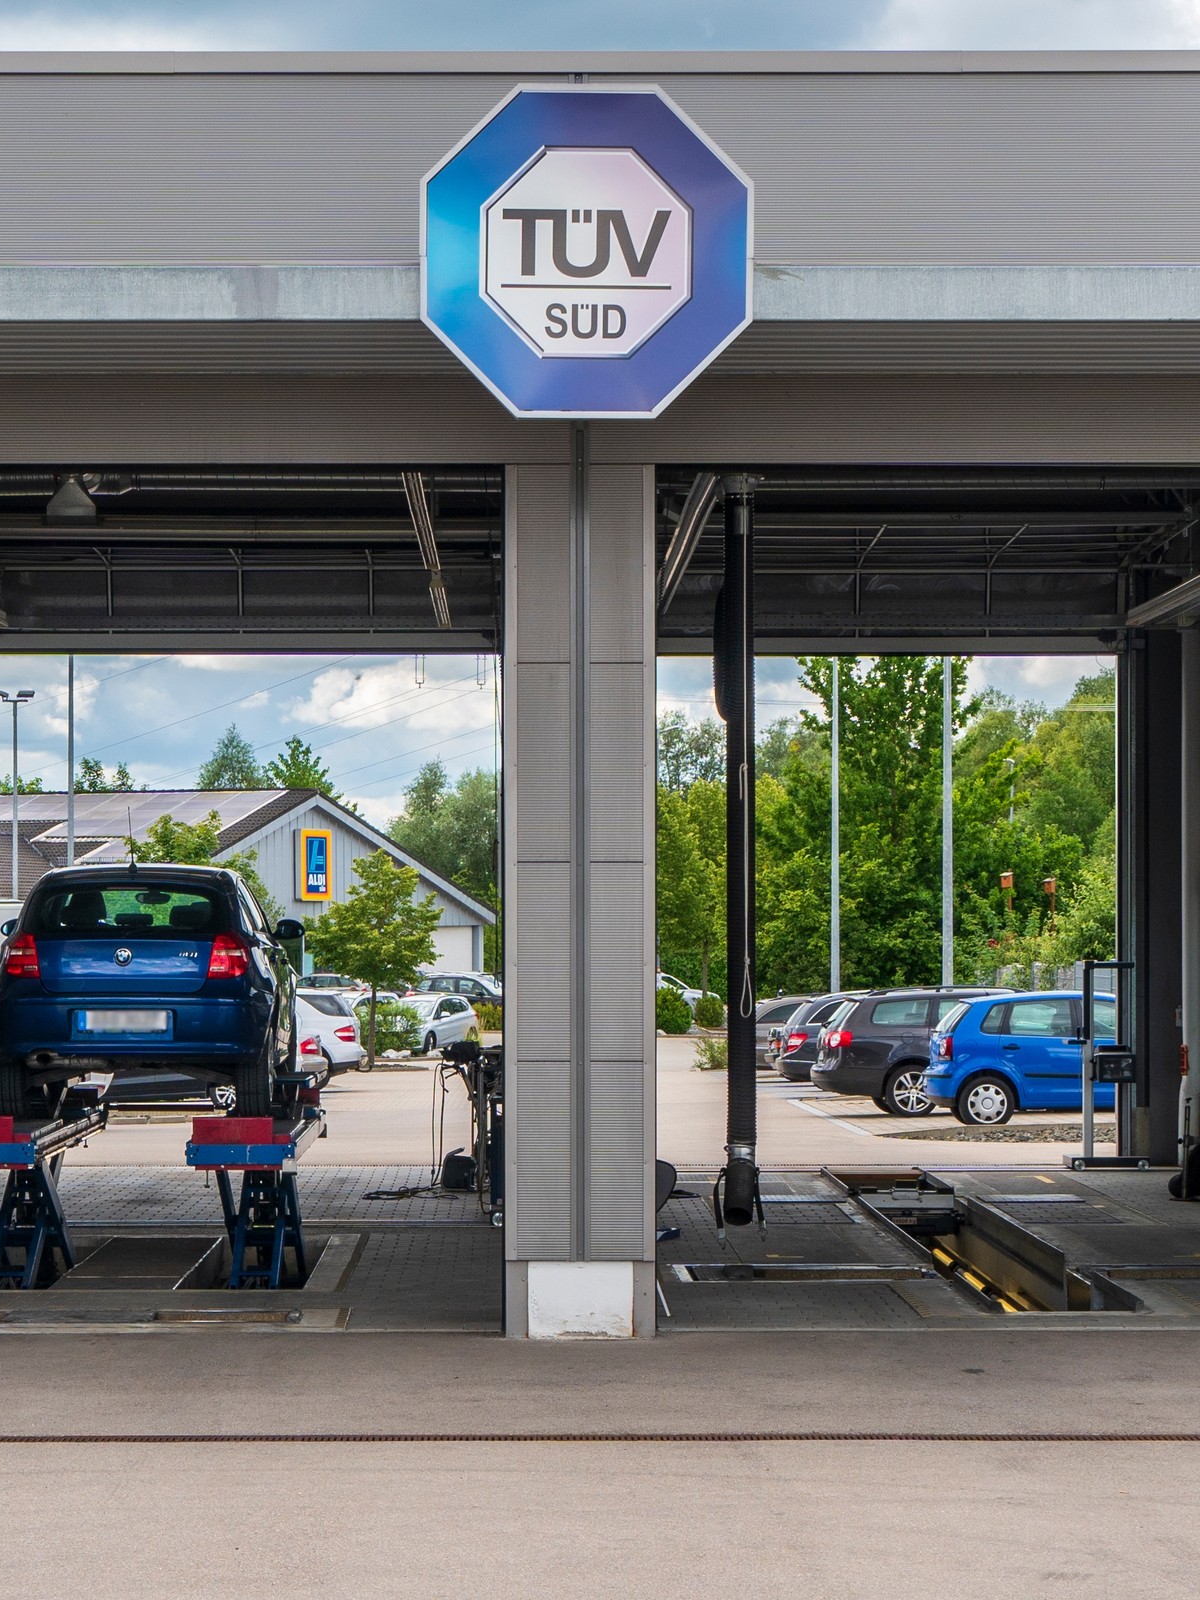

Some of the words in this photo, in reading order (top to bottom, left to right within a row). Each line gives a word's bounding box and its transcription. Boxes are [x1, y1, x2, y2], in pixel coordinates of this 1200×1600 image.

[502, 208, 673, 279] TÜV
[544, 302, 628, 340] SÜD
[308, 874, 326, 886] ALDI
